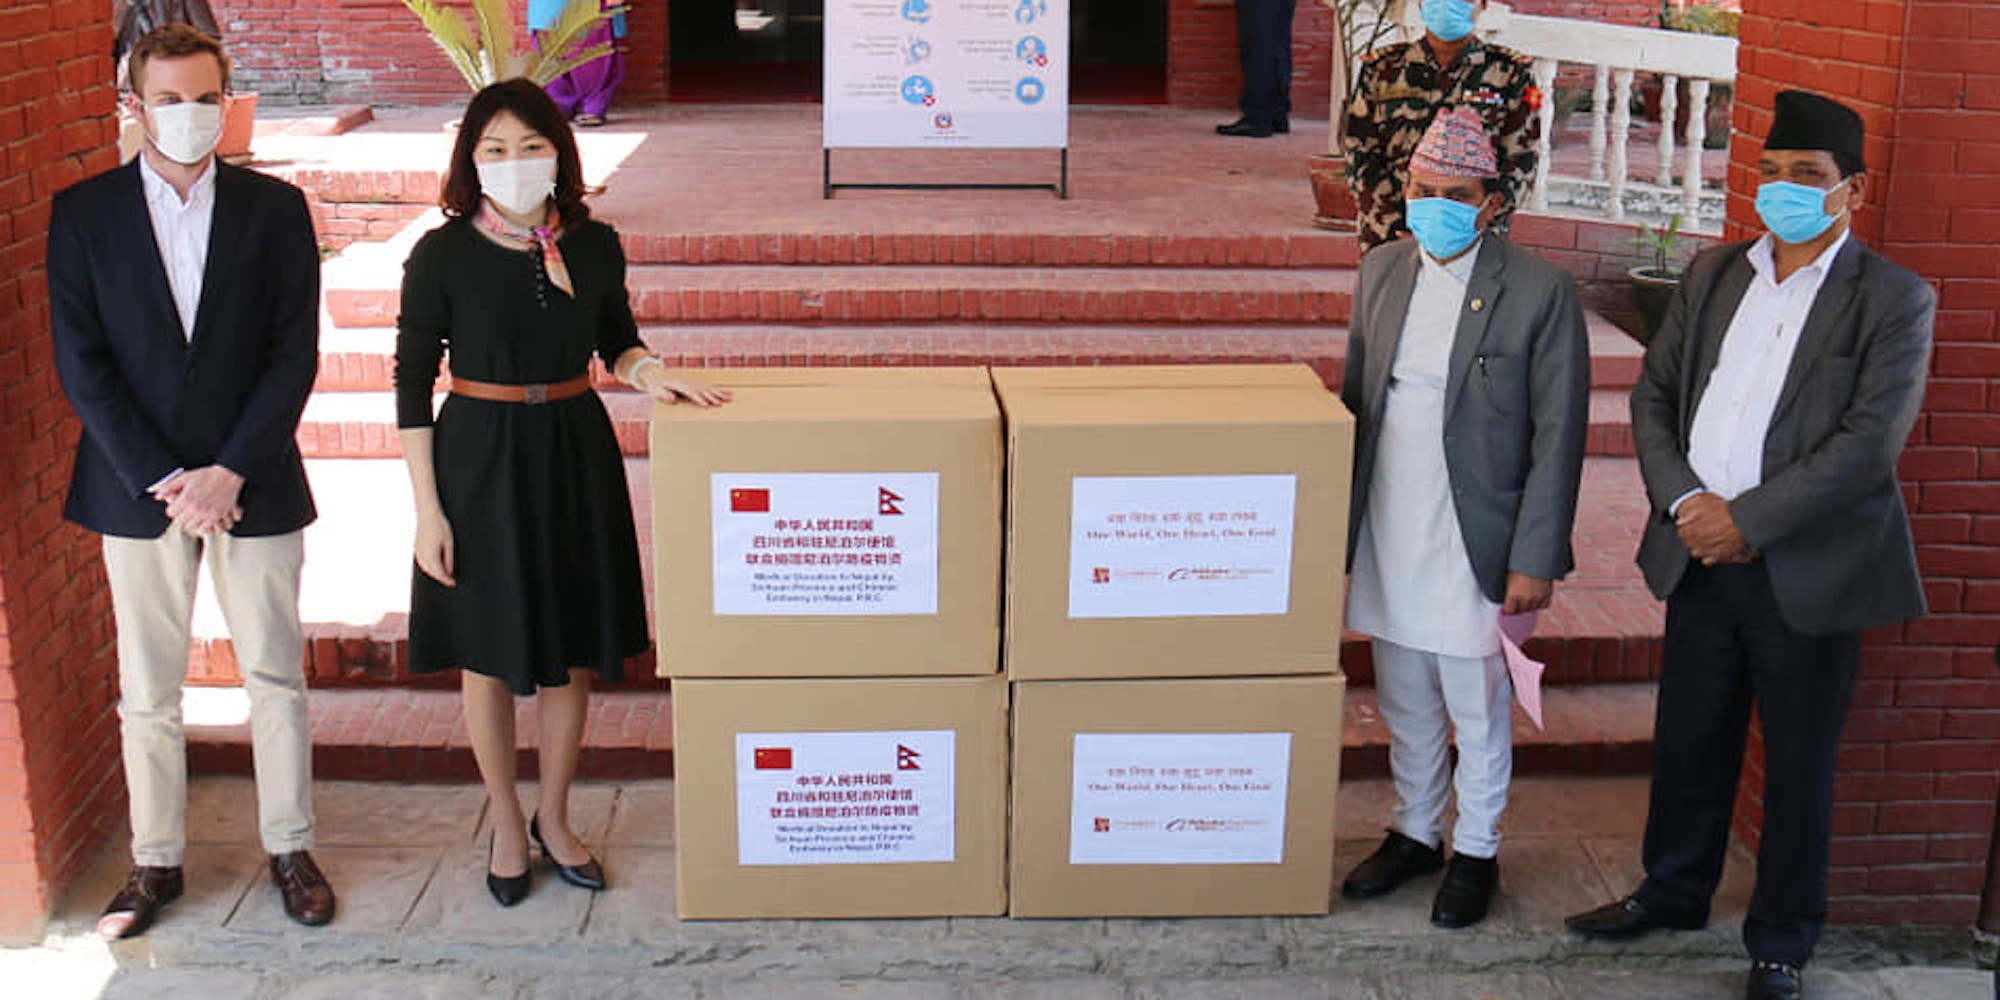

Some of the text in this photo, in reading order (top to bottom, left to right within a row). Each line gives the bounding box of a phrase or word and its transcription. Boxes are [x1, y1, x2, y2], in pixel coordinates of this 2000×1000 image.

[774, 518, 875, 532] 中华人民共和国
[795, 774, 893, 787] 中华人民共和国
